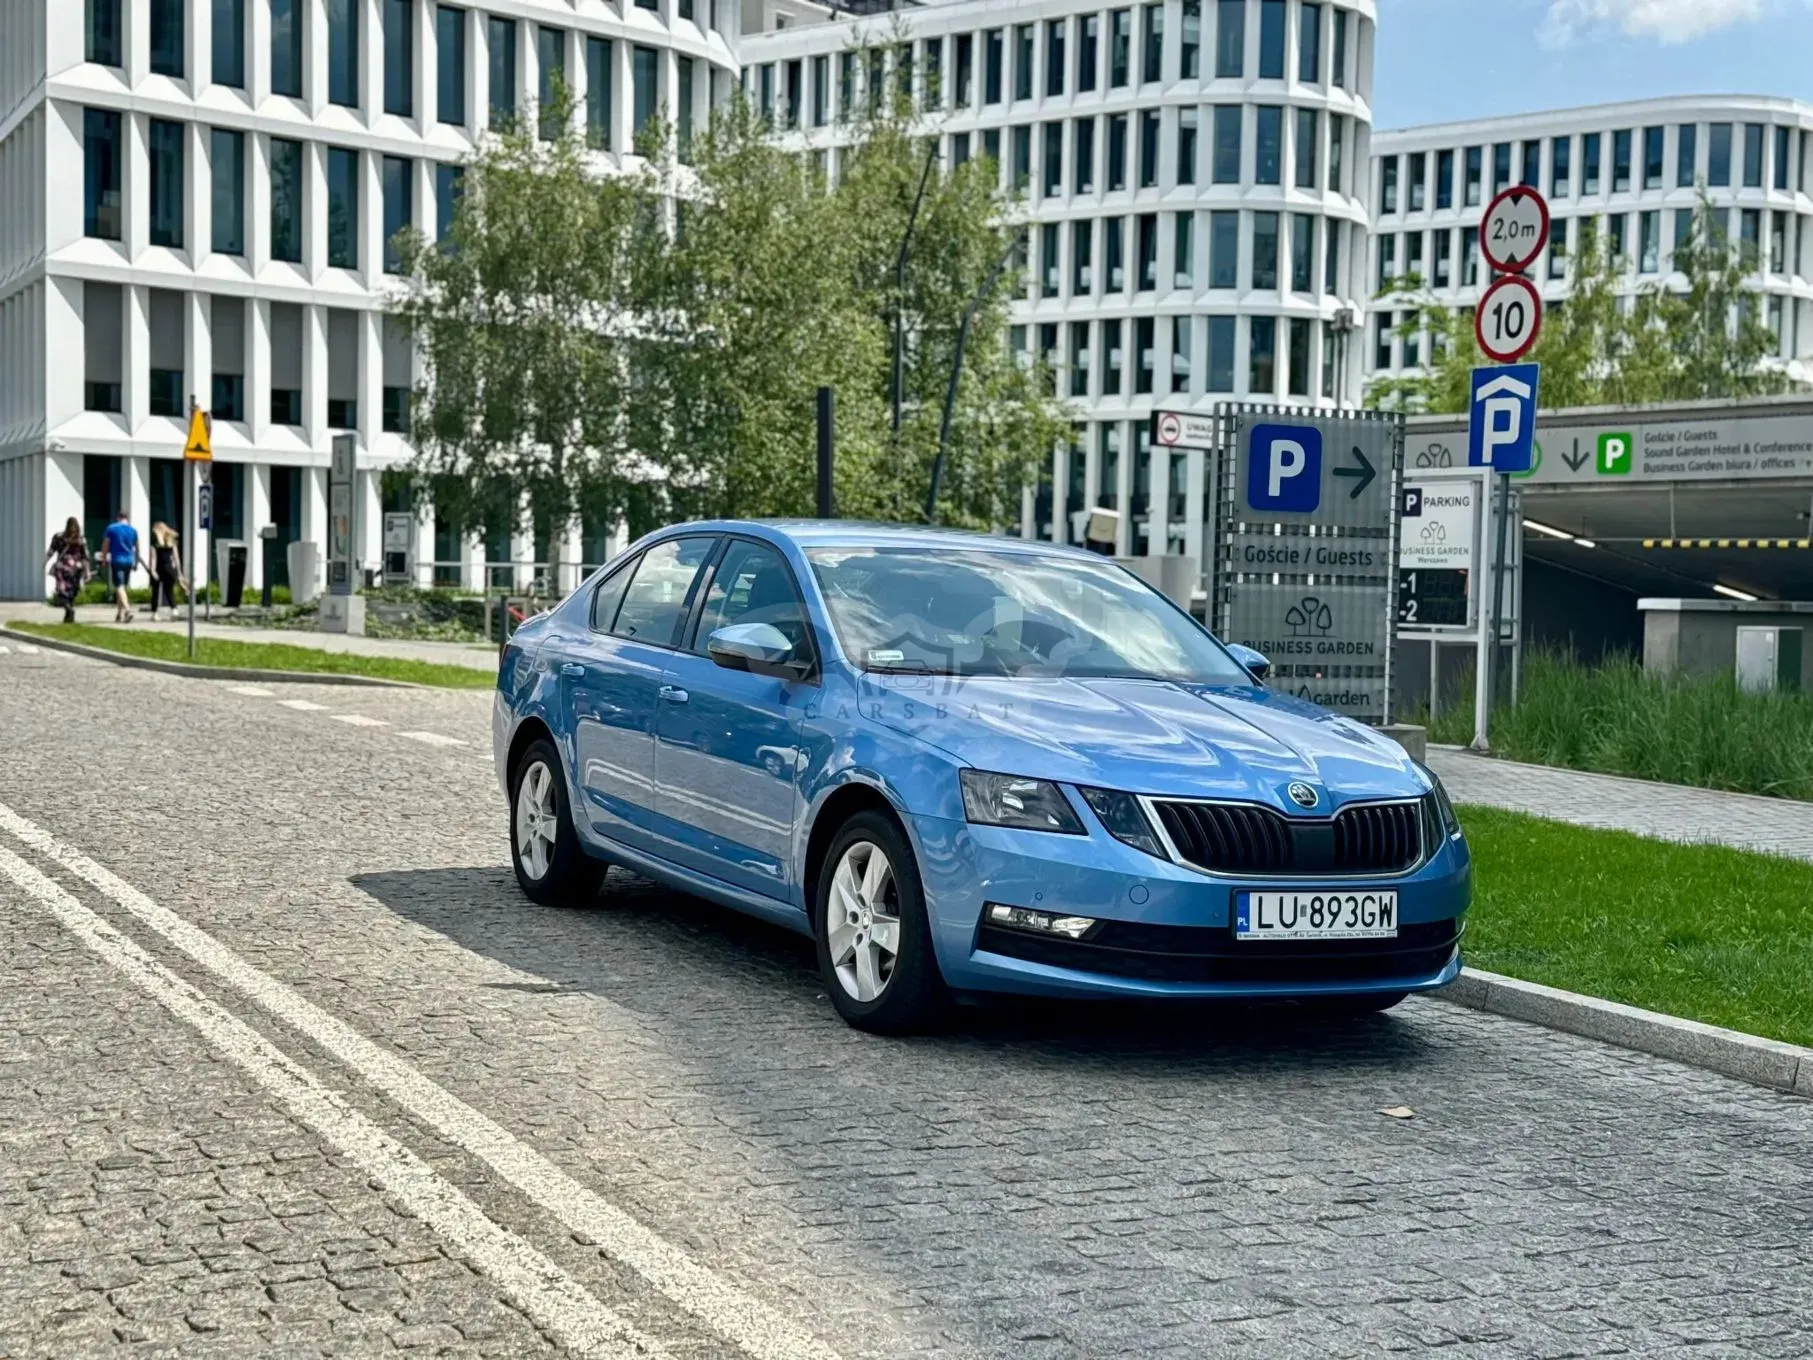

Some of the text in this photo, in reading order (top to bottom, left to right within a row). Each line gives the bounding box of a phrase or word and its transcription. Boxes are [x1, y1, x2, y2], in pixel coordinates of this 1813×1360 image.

[1493, 218, 1535, 242] 2,0 m
[1492, 301, 1524, 340] 10
[1482, 397, 1521, 463] P
[1683, 430, 1718, 441] Guests
[1605, 439, 1625, 468] P
[1644, 446, 1673, 458] Sound
[1676, 445, 1710, 457] Garden
[1713, 444, 1741, 455] Hotel
[1753, 441, 1812, 453] Conference
[1268, 439, 1306, 497] P
[1643, 461, 1685, 473] Business
[1688, 460, 1723, 471] Garden
[1761, 458, 1796, 470] offices
[1406, 494, 1418, 511] P
[1423, 496, 1470, 508] PARKING
[1244, 545, 1299, 564] Goście
[1316, 547, 1373, 566] Guests
[1437, 546, 1469, 555] GARDEN
[1317, 642, 1374, 655] GARDEN
[1257, 895, 1394, 929] LU 893GW
[1237, 917, 1248, 926] PL
